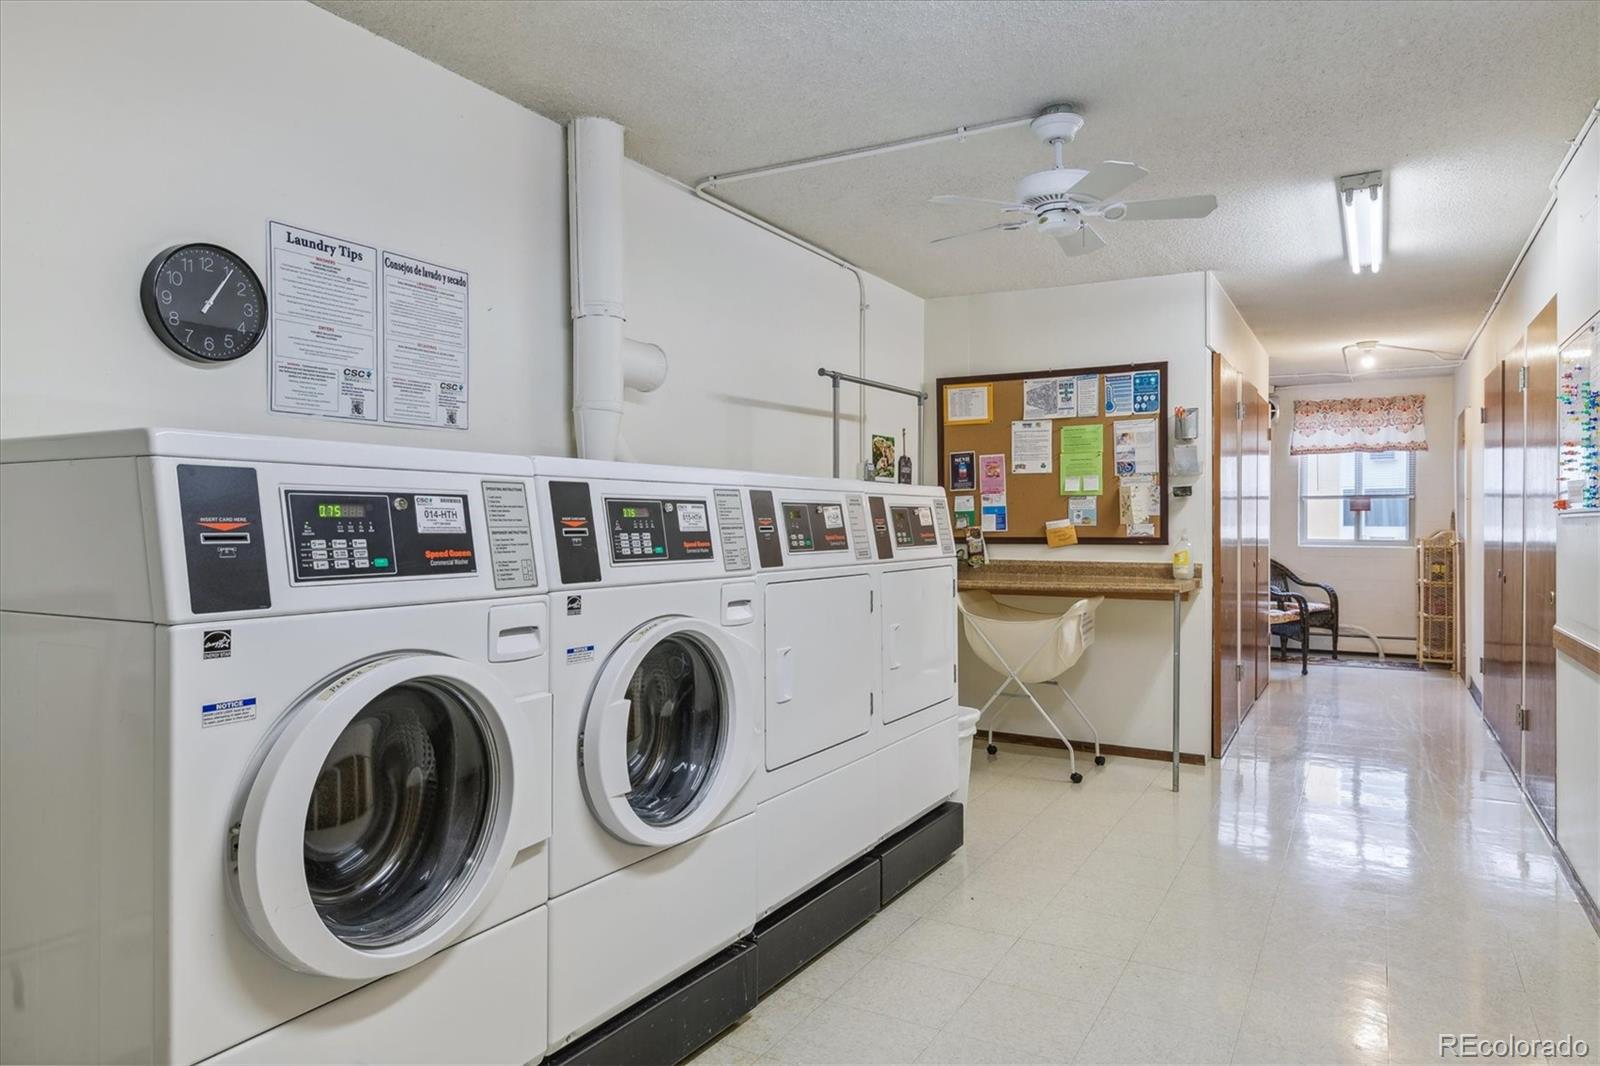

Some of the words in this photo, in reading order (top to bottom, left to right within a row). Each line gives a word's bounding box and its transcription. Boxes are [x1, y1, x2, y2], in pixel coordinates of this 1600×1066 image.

[286, 231, 336, 257] Laundry
[338, 245, 363, 262] Tips
[181, 258, 193, 272] 11
[199, 257, 214, 272] 12
[166, 270, 183, 286] 10
[384, 257, 413, 275] Consejos
[414, 265, 421, 276] de
[422, 266, 441, 281] lavado
[443, 275, 446, 284] y
[447, 276, 466, 287] secado
[237, 282, 246, 296] 2
[161, 289, 172, 304] 9
[243, 303, 254, 317] 3
[169, 311, 180, 326] 8
[185, 328, 194, 342] 7
[237, 322, 246, 335] 4
[204, 337, 215, 351] 6
[224, 334, 234, 348] 5
[343, 368, 365, 378] CSC
[440, 382, 458, 391] CSC
[424, 510, 458, 519] 014-HTH
[425, 549, 449, 559] Speed
[449, 549, 472, 557] Queen
[216, 700, 244, 710] NOTICE
